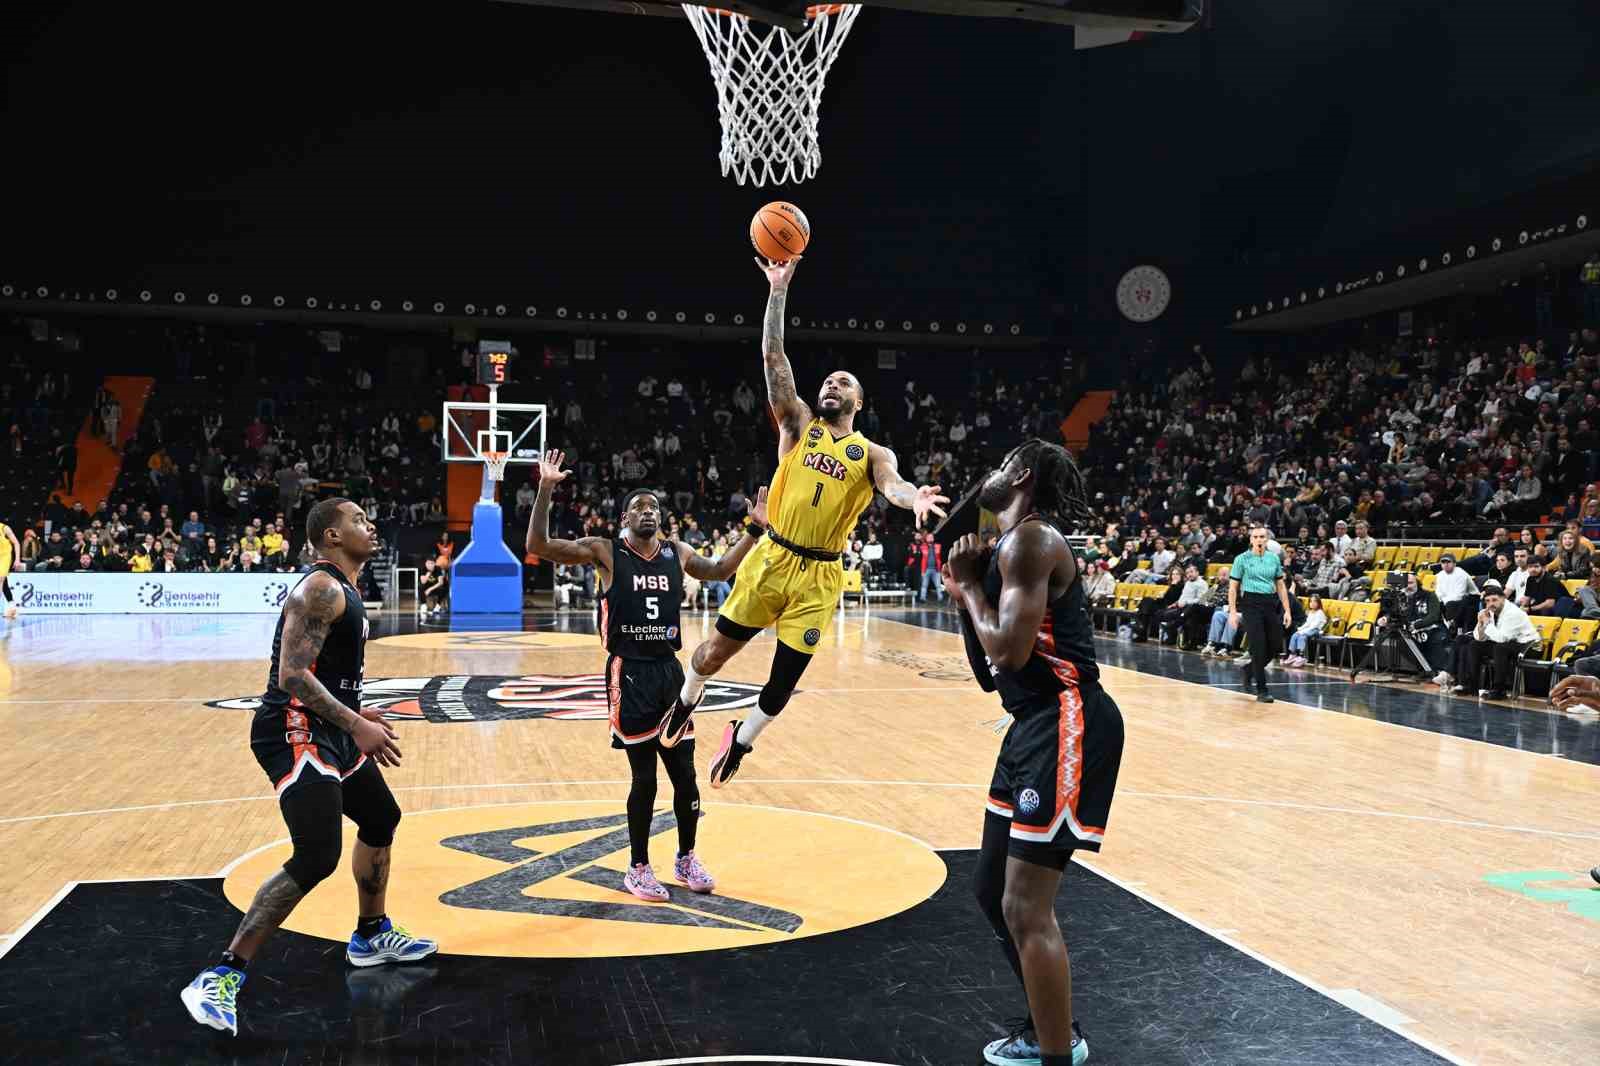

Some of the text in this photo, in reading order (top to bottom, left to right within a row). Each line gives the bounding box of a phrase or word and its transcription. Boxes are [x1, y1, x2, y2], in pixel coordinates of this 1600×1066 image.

[495, 365, 504, 381] 5
[804, 453, 847, 481] MSK
[812, 482, 824, 507] 1
[633, 575, 669, 591] MSB
[646, 597, 659, 619] 5
[621, 625, 666, 633] E.Leclerc
